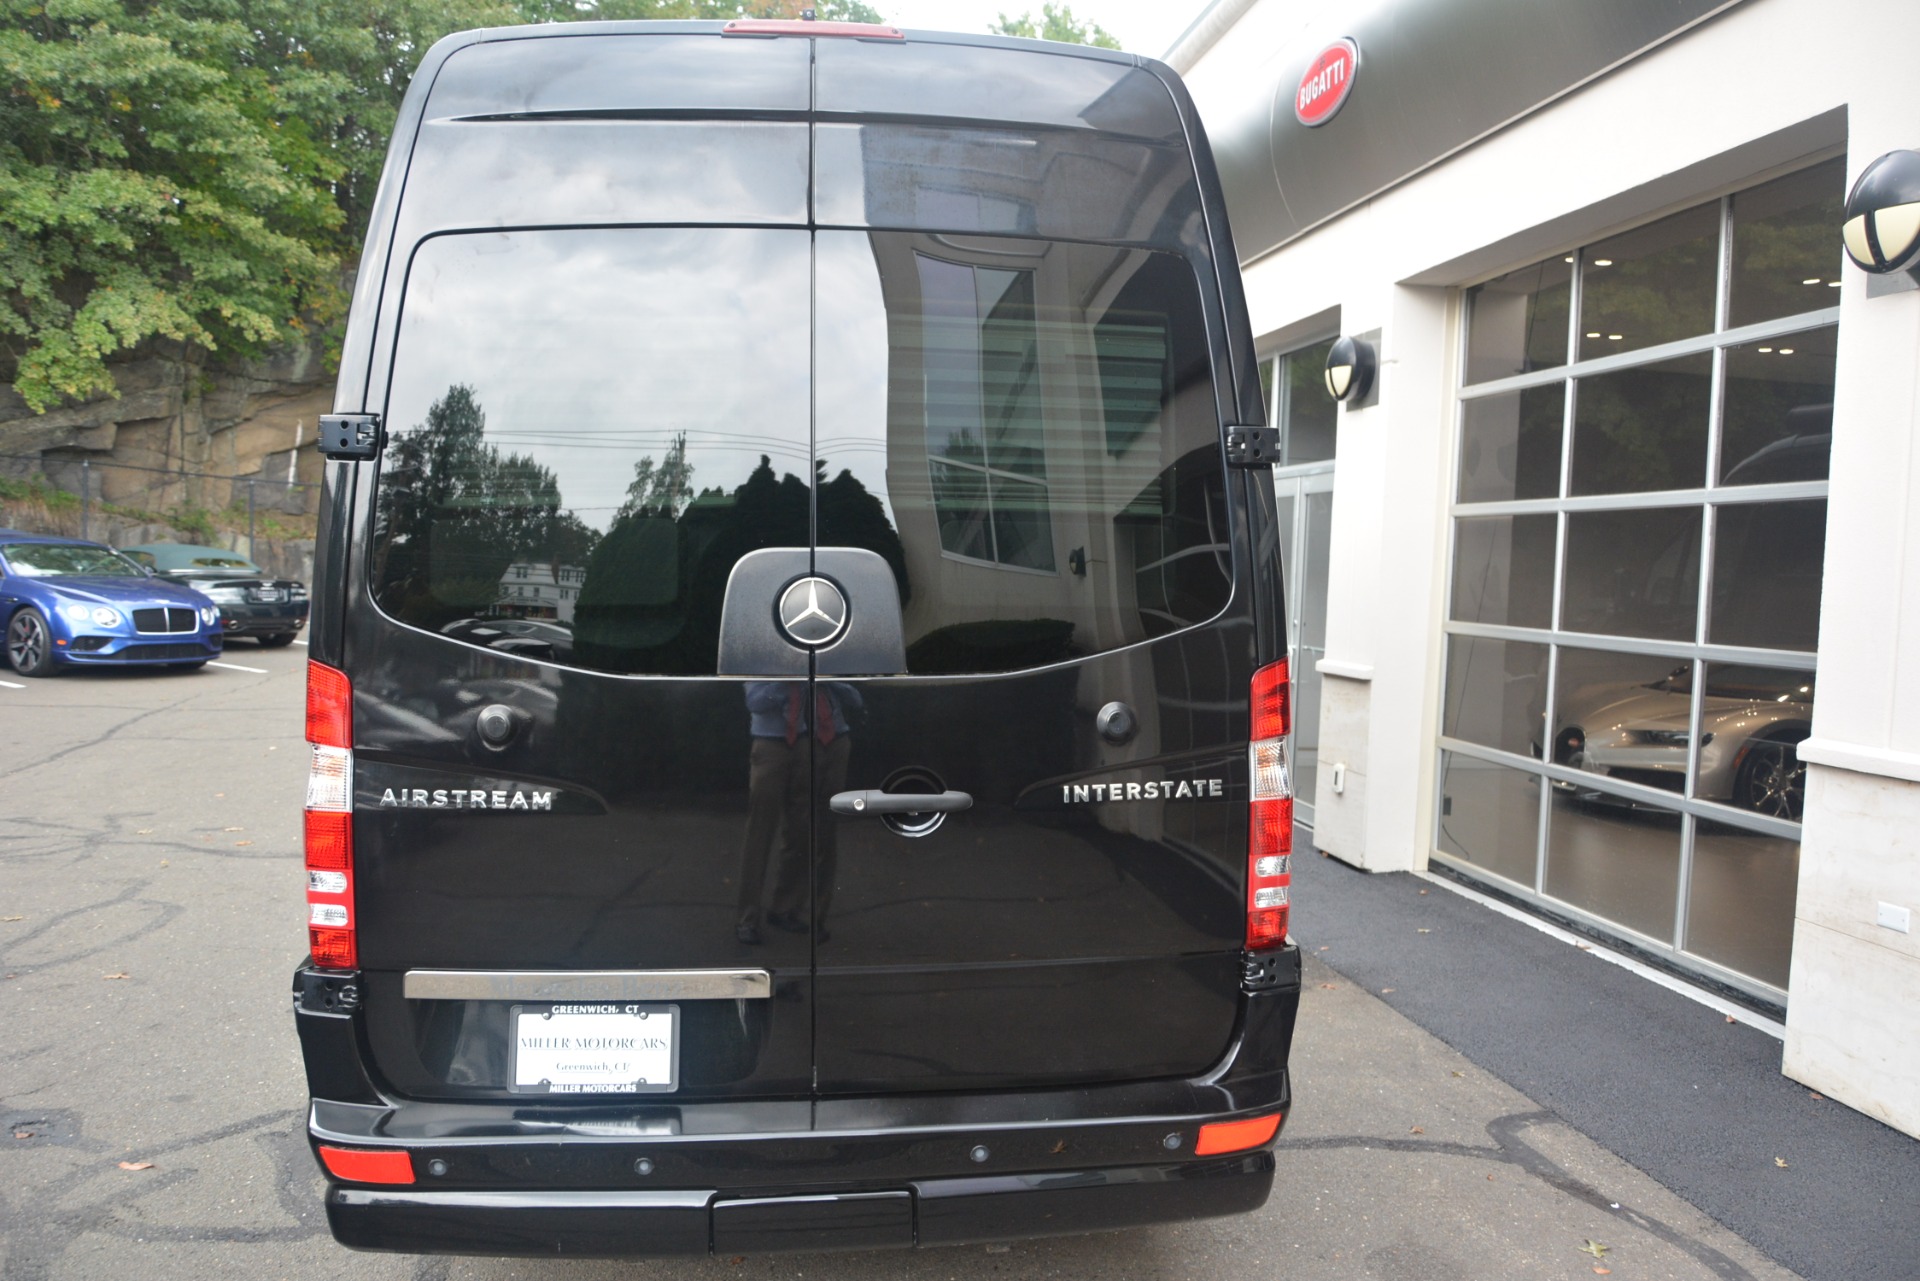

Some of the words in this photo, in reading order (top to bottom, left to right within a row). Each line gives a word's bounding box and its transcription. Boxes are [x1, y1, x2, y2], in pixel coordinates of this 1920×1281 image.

[1300, 57, 1345, 110] BUGATTI
[1063, 779, 1223, 803] INTERSTATE
[379, 788, 552, 810] AIRSTREAM
[625, 1005, 639, 1014] CT
[521, 1037, 571, 1049] MILLER
[576, 1037, 668, 1049] MOTORCARS
[556, 1061, 613, 1074] Greenwich,
[549, 1084, 581, 1093] MILLER
[582, 1084, 637, 1093] MOTORCARS
